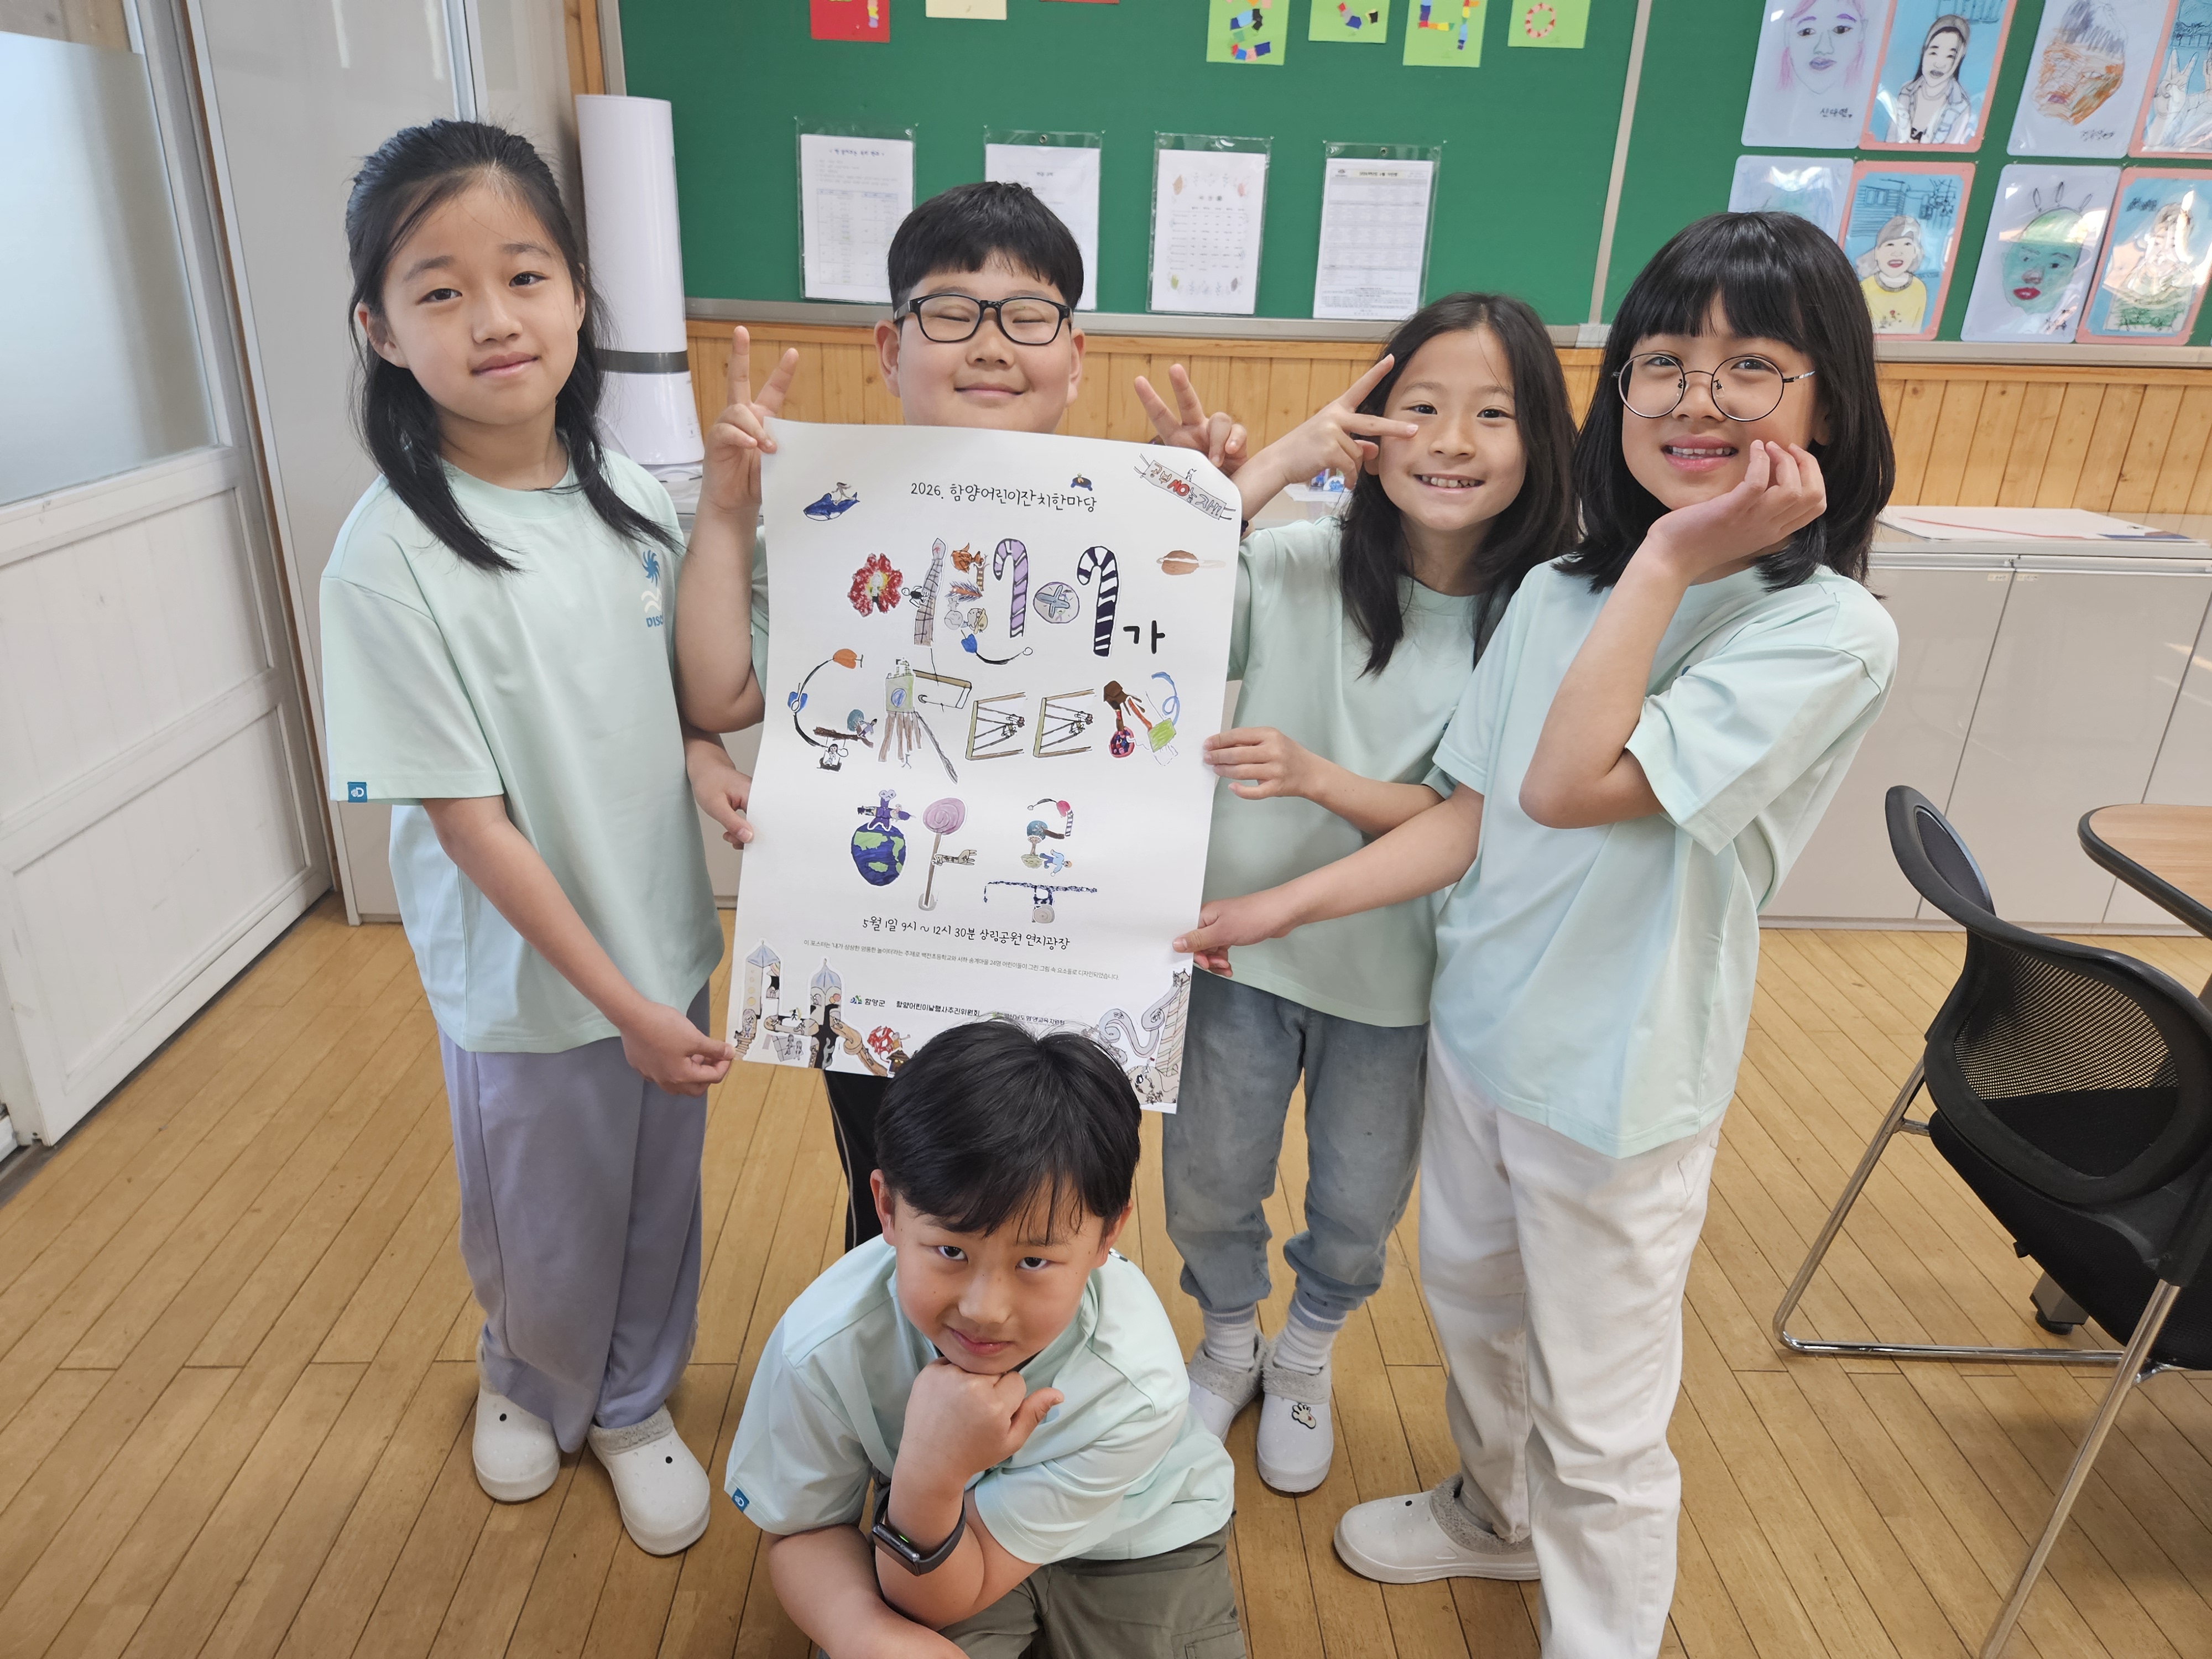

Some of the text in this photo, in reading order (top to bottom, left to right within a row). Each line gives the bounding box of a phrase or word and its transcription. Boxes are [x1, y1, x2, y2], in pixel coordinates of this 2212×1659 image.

[910, 482, 944, 499] 2026.
[862, 915, 881, 932] 5월
[885, 918, 898, 932] 1일
[901, 921, 916, 932] 9시
[933, 925, 951, 935] 12시
[954, 927, 976, 940] 30분
[979, 928, 1022, 946] 상림공원
[1026, 933, 1070, 951] 연지광장
[810, 940, 831, 949] 포스터는
[1002, 961, 1027, 970] 어린이들이
[865, 998, 885, 1008] 함양군
